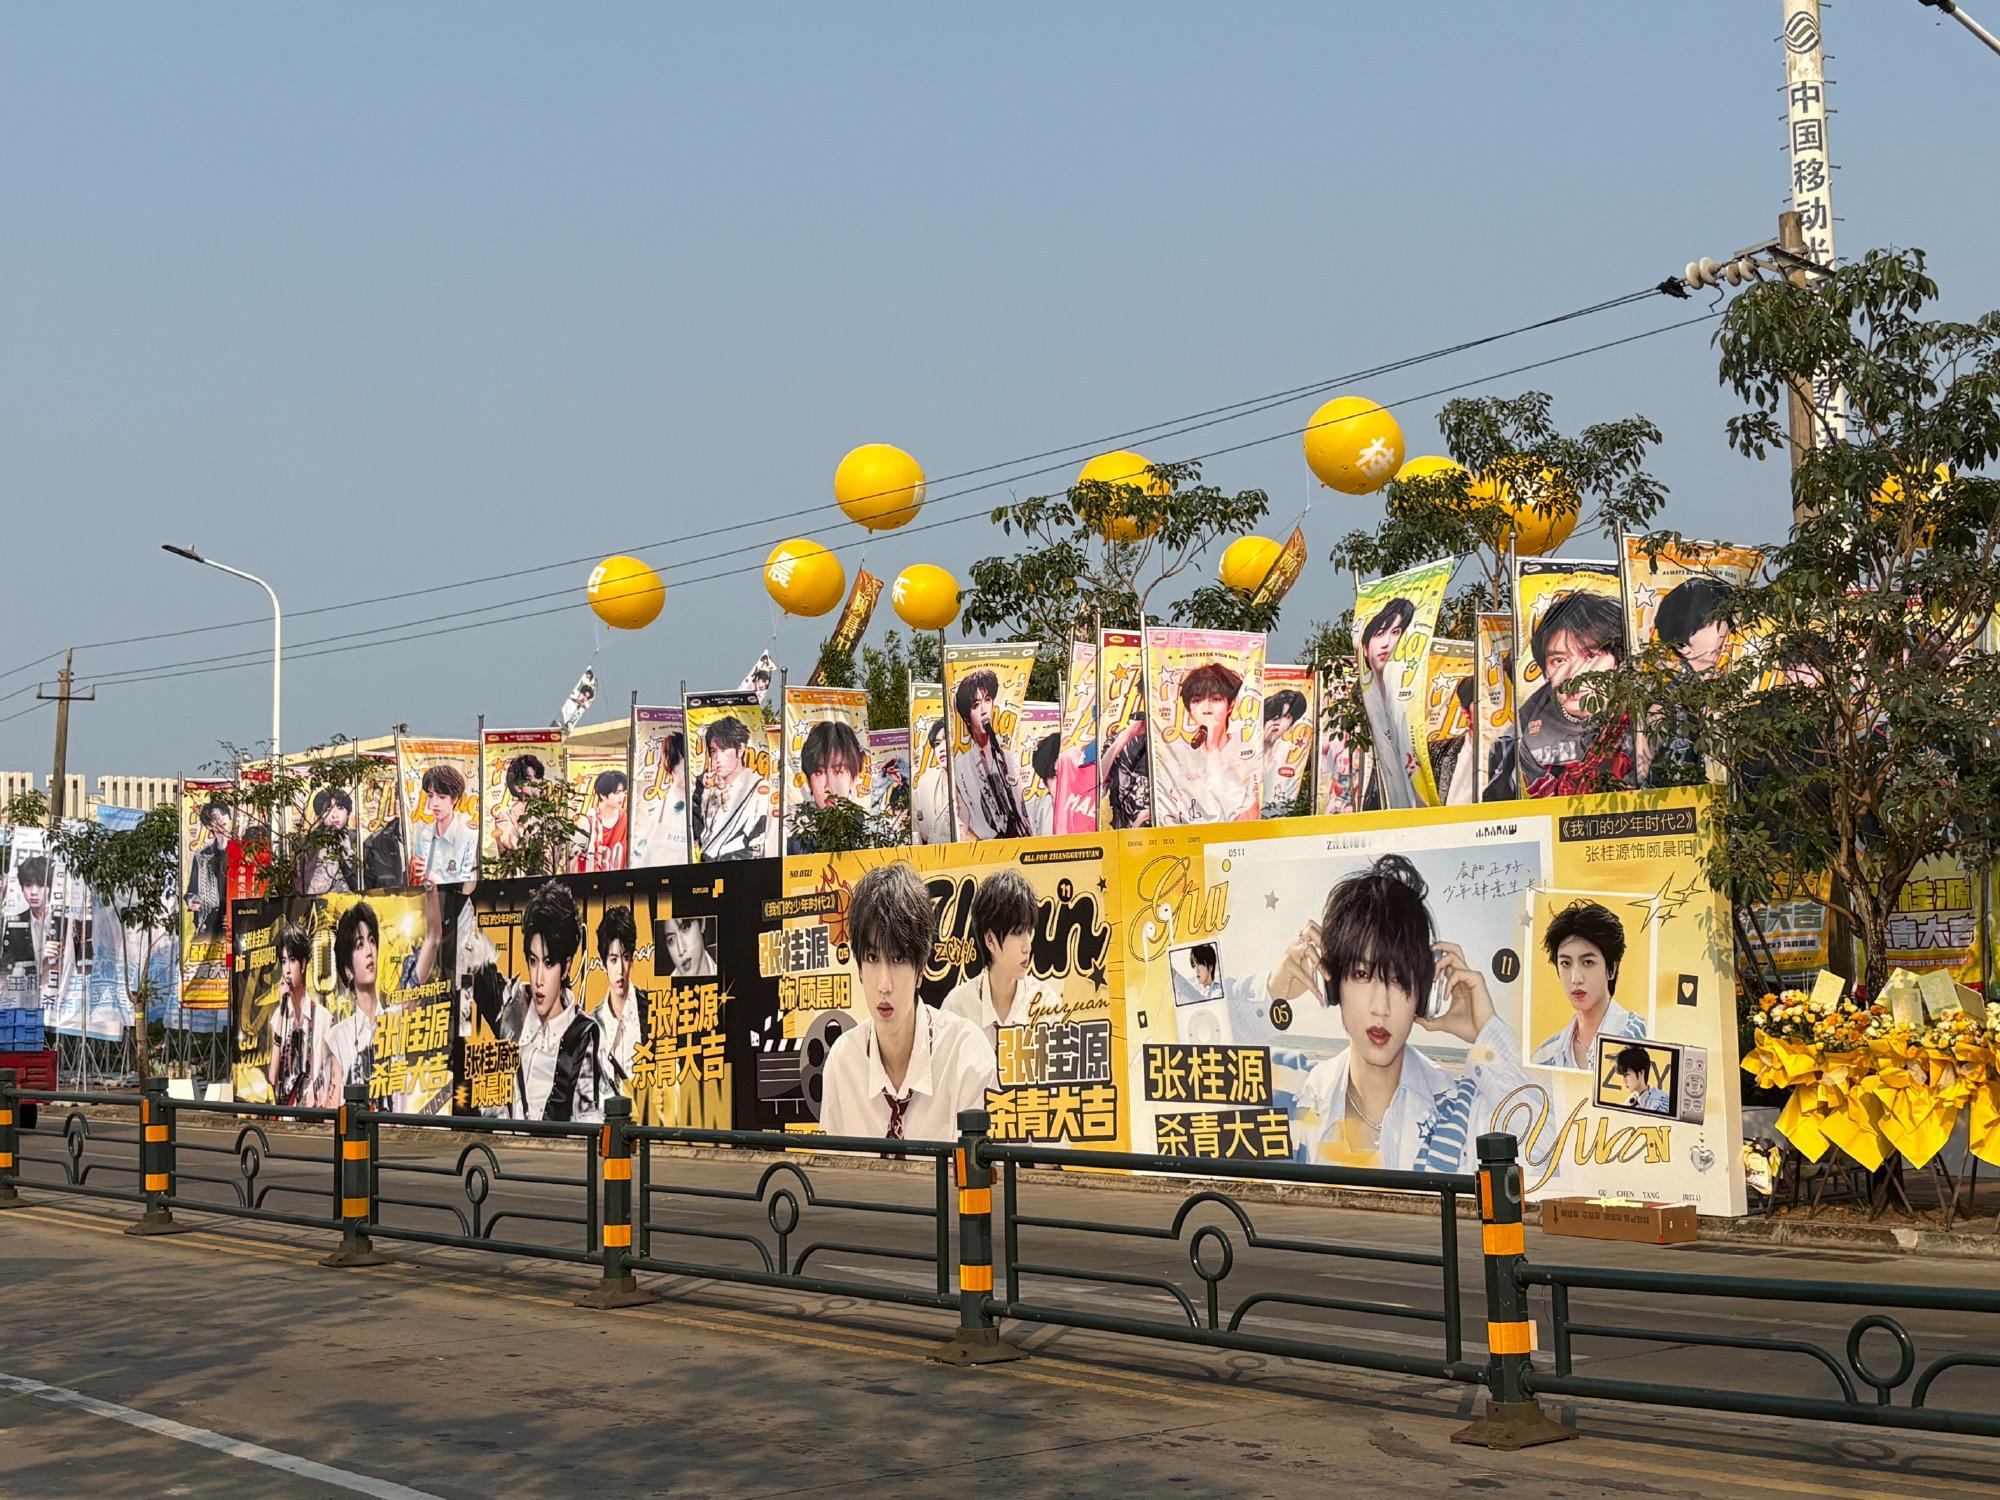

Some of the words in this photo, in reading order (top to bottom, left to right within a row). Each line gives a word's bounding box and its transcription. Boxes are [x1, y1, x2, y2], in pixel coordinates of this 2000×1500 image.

[1561, 813, 1694, 838] 《我们的少年时代2》
[1585, 840, 1696, 863] 张桂源饰顾晨阳
[759, 924, 830, 978] 张桂源
[1883, 913, 1976, 950] 青大吉
[373, 1001, 452, 1060] 张桂源
[647, 983, 719, 1040] 张桂源
[1272, 1004, 1289, 1024] 05
[368, 1051, 449, 1099] 杀青大吉
[631, 1029, 727, 1090] 杀青大吉
[997, 1020, 1112, 1086] 张桂源
[1148, 1046, 1267, 1103] 张桂源
[985, 1085, 1117, 1142] 杀青大吉
[1157, 1109, 1290, 1159] 杀青大吉
